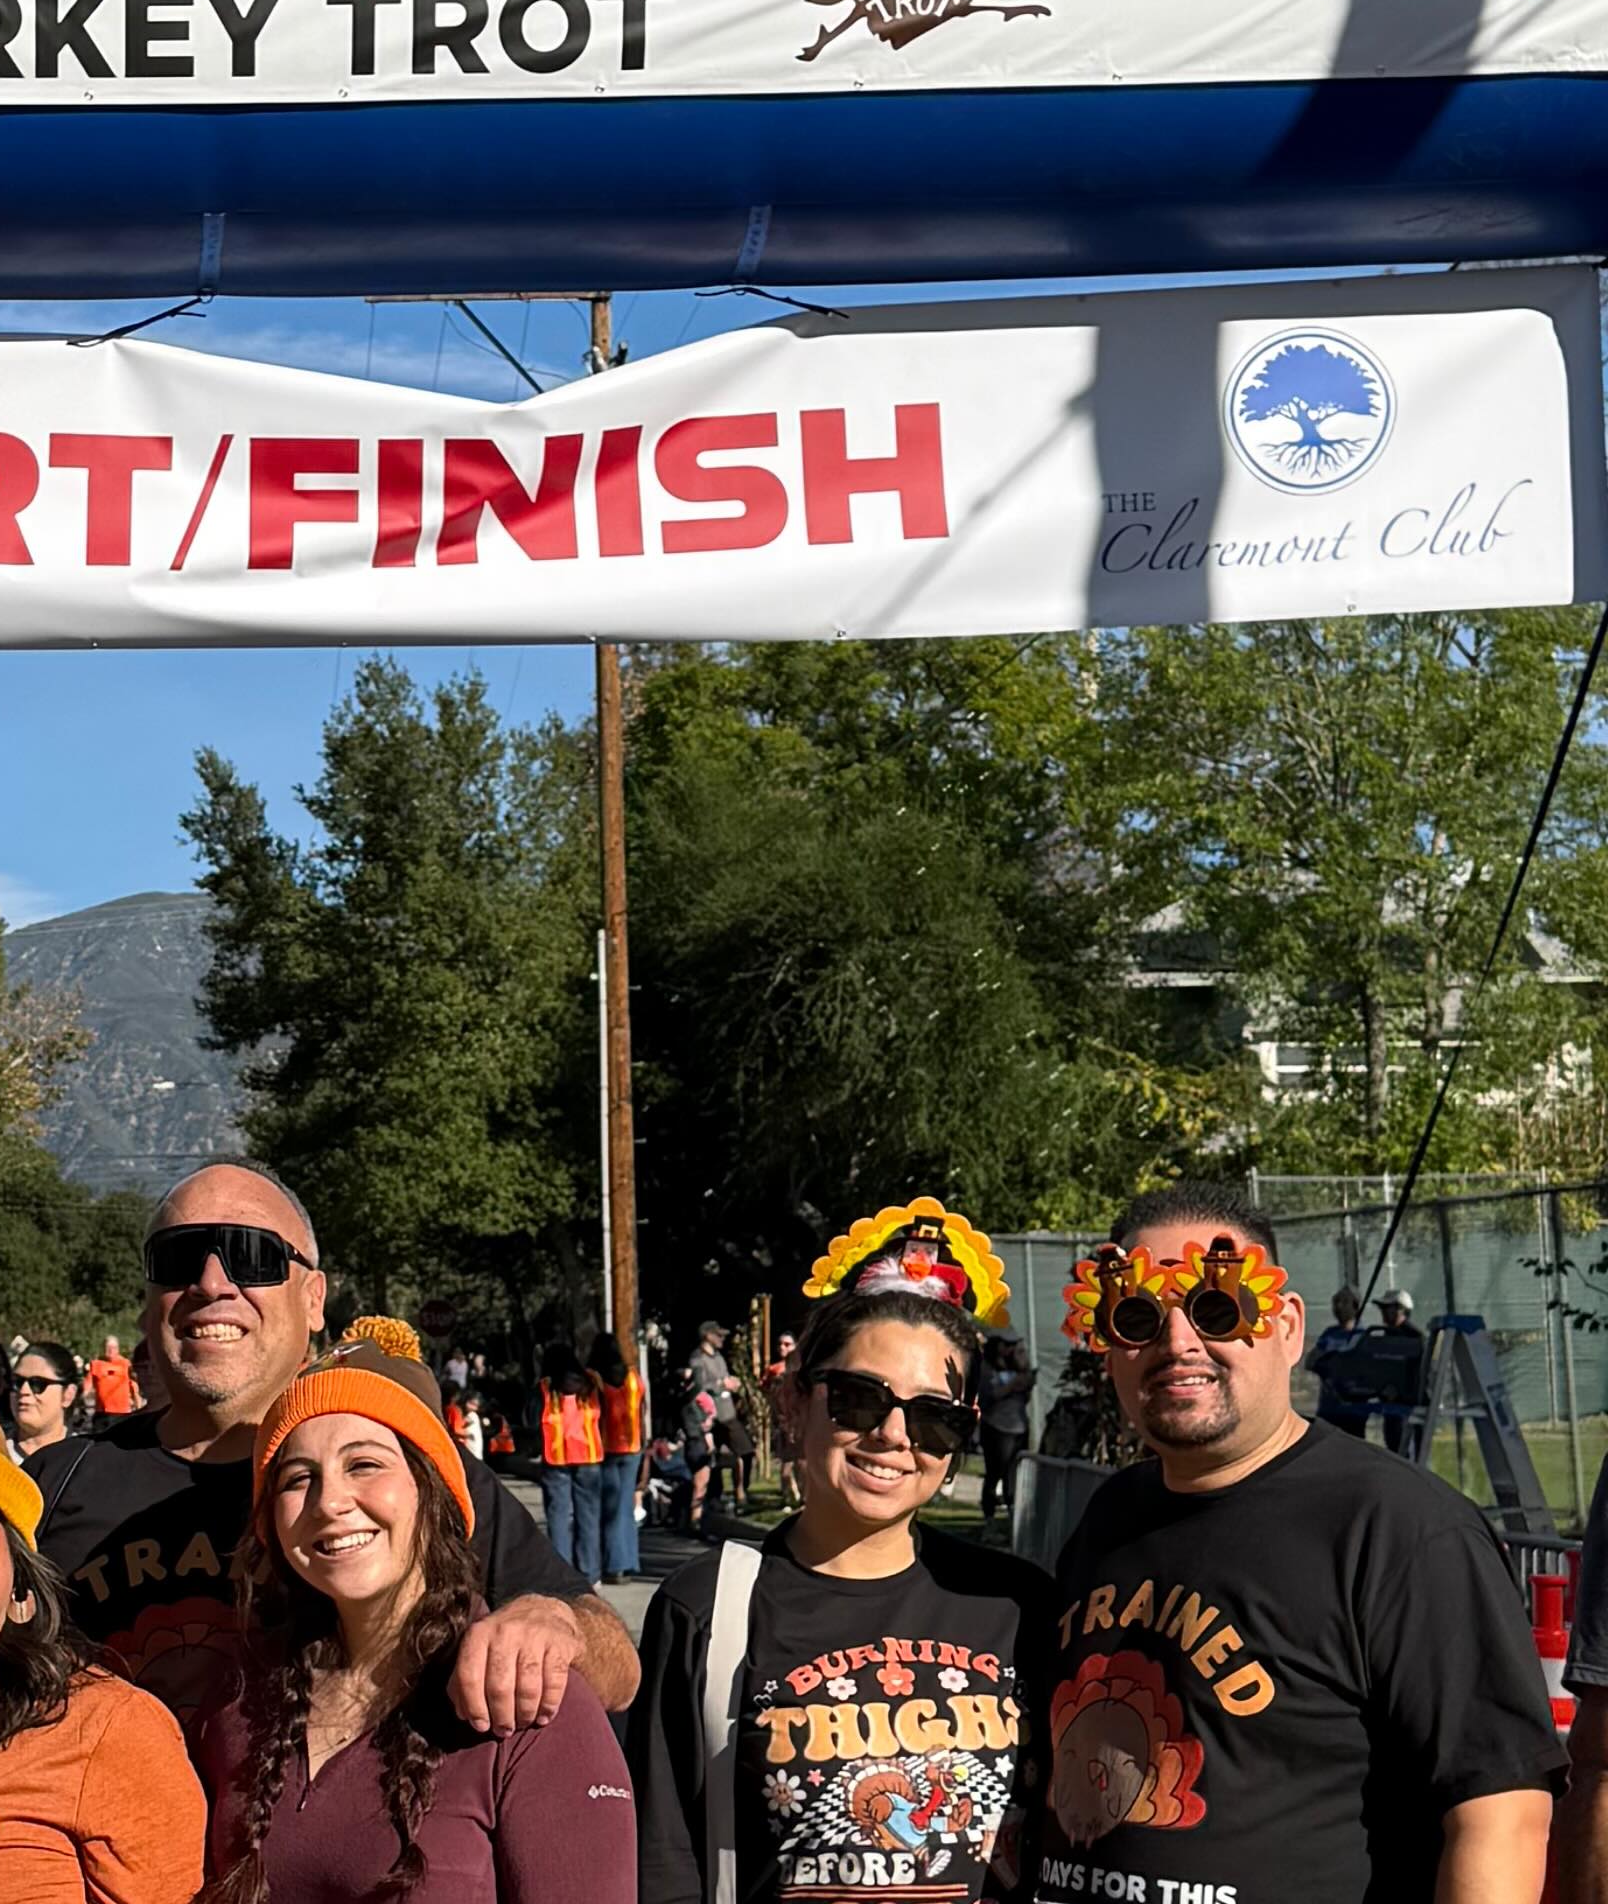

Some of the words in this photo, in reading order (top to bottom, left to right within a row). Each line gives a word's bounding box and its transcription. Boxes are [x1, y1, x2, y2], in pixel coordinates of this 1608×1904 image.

[1101, 497, 1356, 574] Claremont
[1379, 478, 1532, 557] Club
[1103, 492, 1156, 513] THE
[785, 1637, 1001, 1696] BURNING
[1057, 1579, 1275, 1716] TRAINED
[777, 1852, 916, 1886] BEFORE
[1092, 1867, 1146, 1903] FOR
